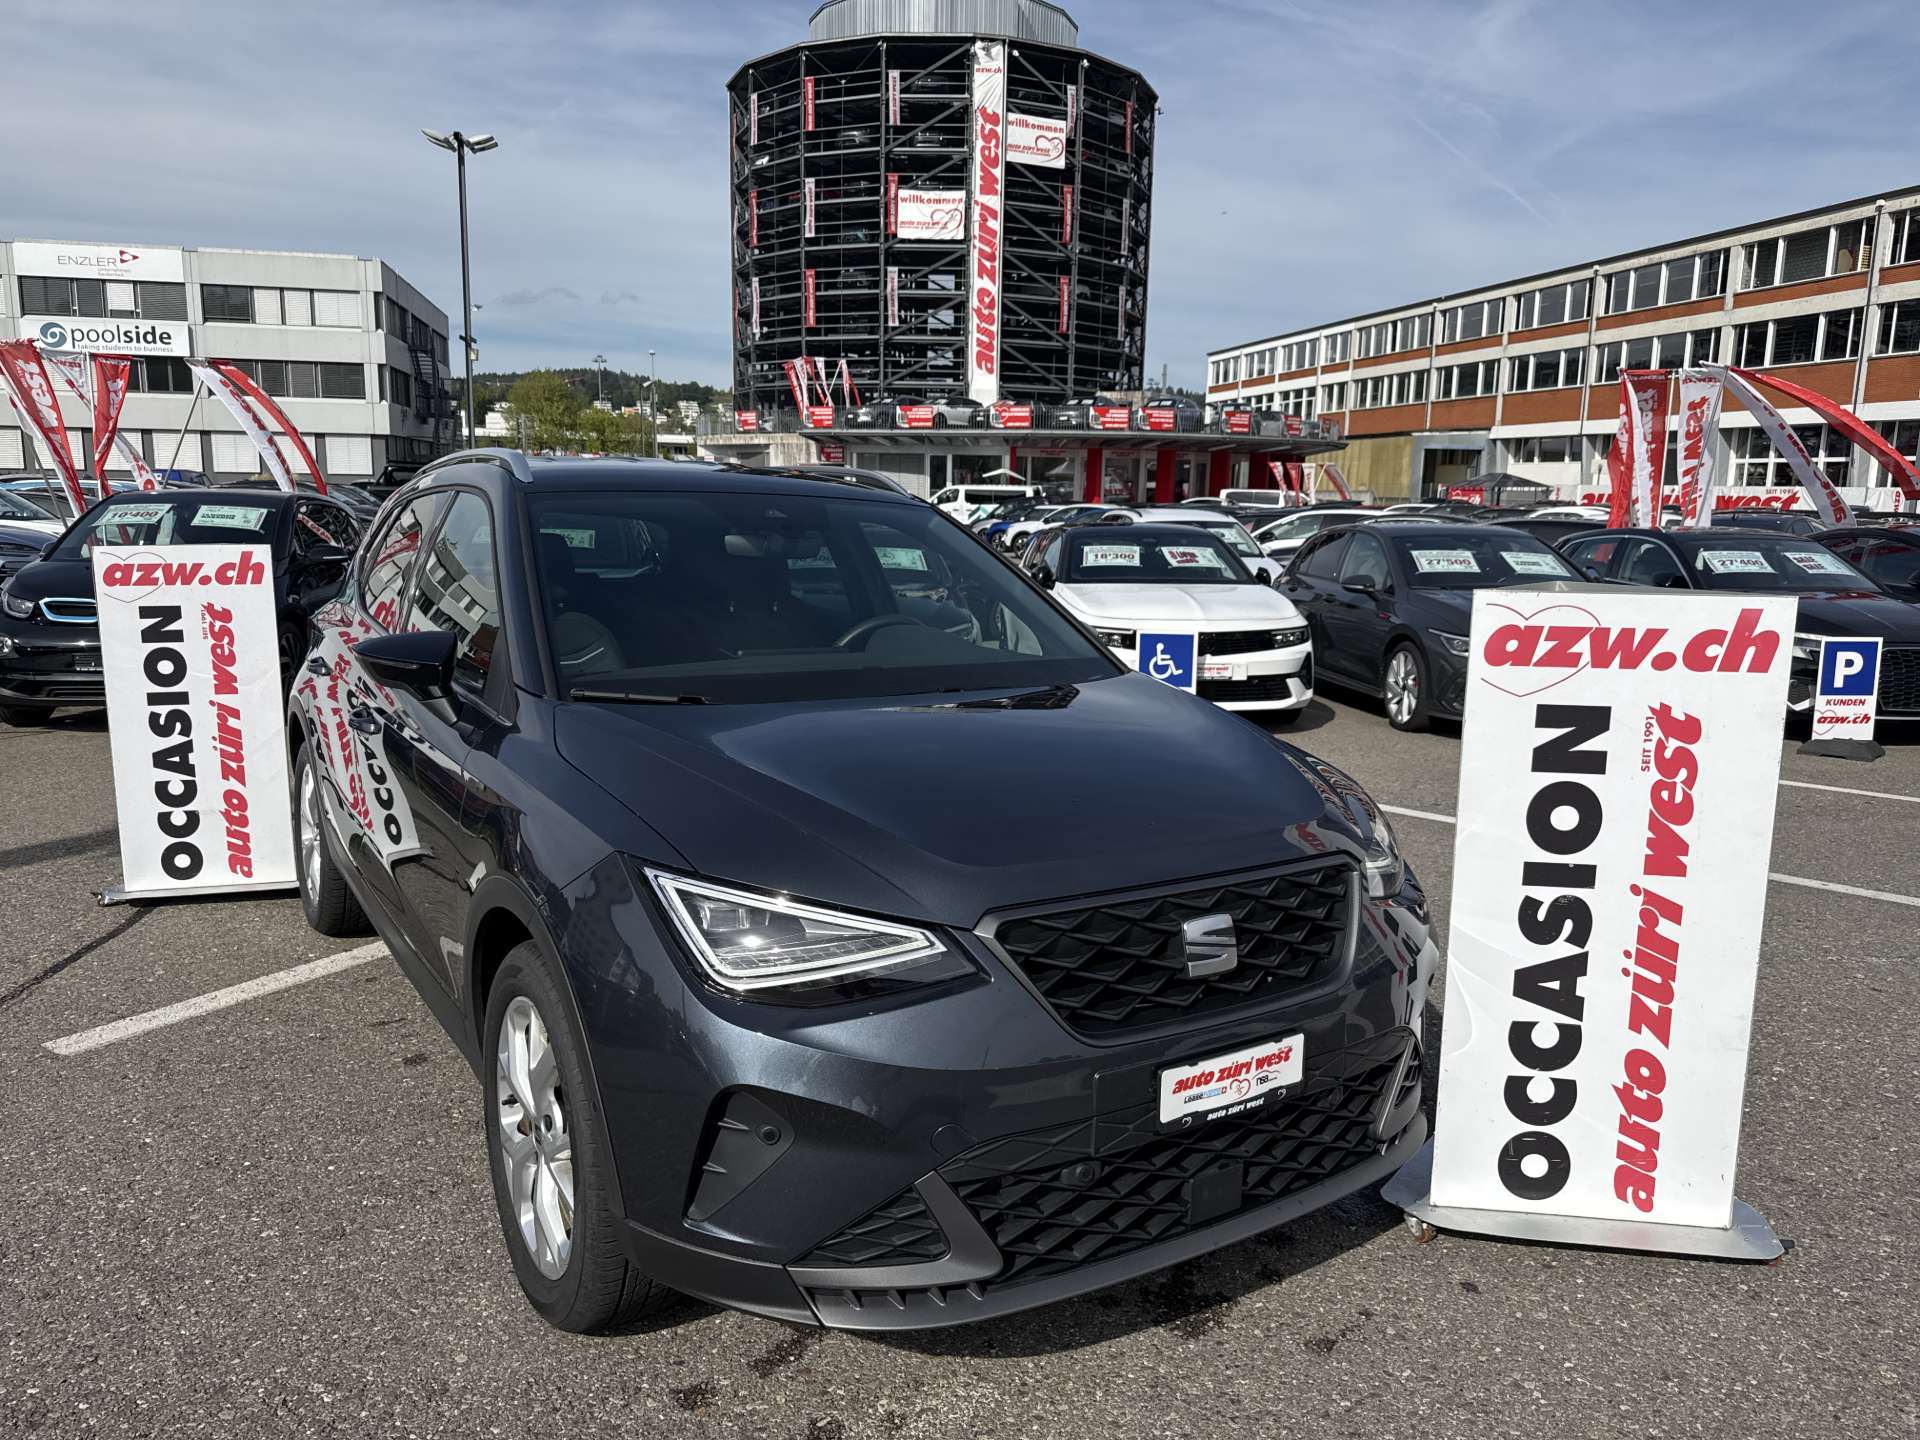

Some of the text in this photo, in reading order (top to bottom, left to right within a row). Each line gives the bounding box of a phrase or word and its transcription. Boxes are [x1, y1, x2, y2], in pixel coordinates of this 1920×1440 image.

[1007, 118, 1065, 134] willkommen
[899, 194, 963, 205] willkommen
[973, 105, 1001, 374] auto züri west
[57, 255, 117, 268] ENZLER
[71, 324, 172, 349] poolside
[77, 344, 100, 352] taking
[101, 344, 133, 352] students
[111, 510, 158, 520] 10'400
[102, 550, 265, 587] azw.ch
[1483, 607, 1781, 673] azw.ch
[1833, 651, 1864, 689] P
[1816, 713, 1871, 724] azw.ch
[1825, 698, 1867, 706] KUNDEN
[138, 604, 203, 881] OCCASION
[201, 602, 254, 879] auto züri west
[1640, 715, 1655, 773] SEIT 1991
[1497, 703, 1612, 1201] OCCASION
[1613, 702, 1703, 1214] auto züri west
[1172, 1045, 1293, 1095] auto züri west
[1206, 1097, 1264, 1121] auto züri west
